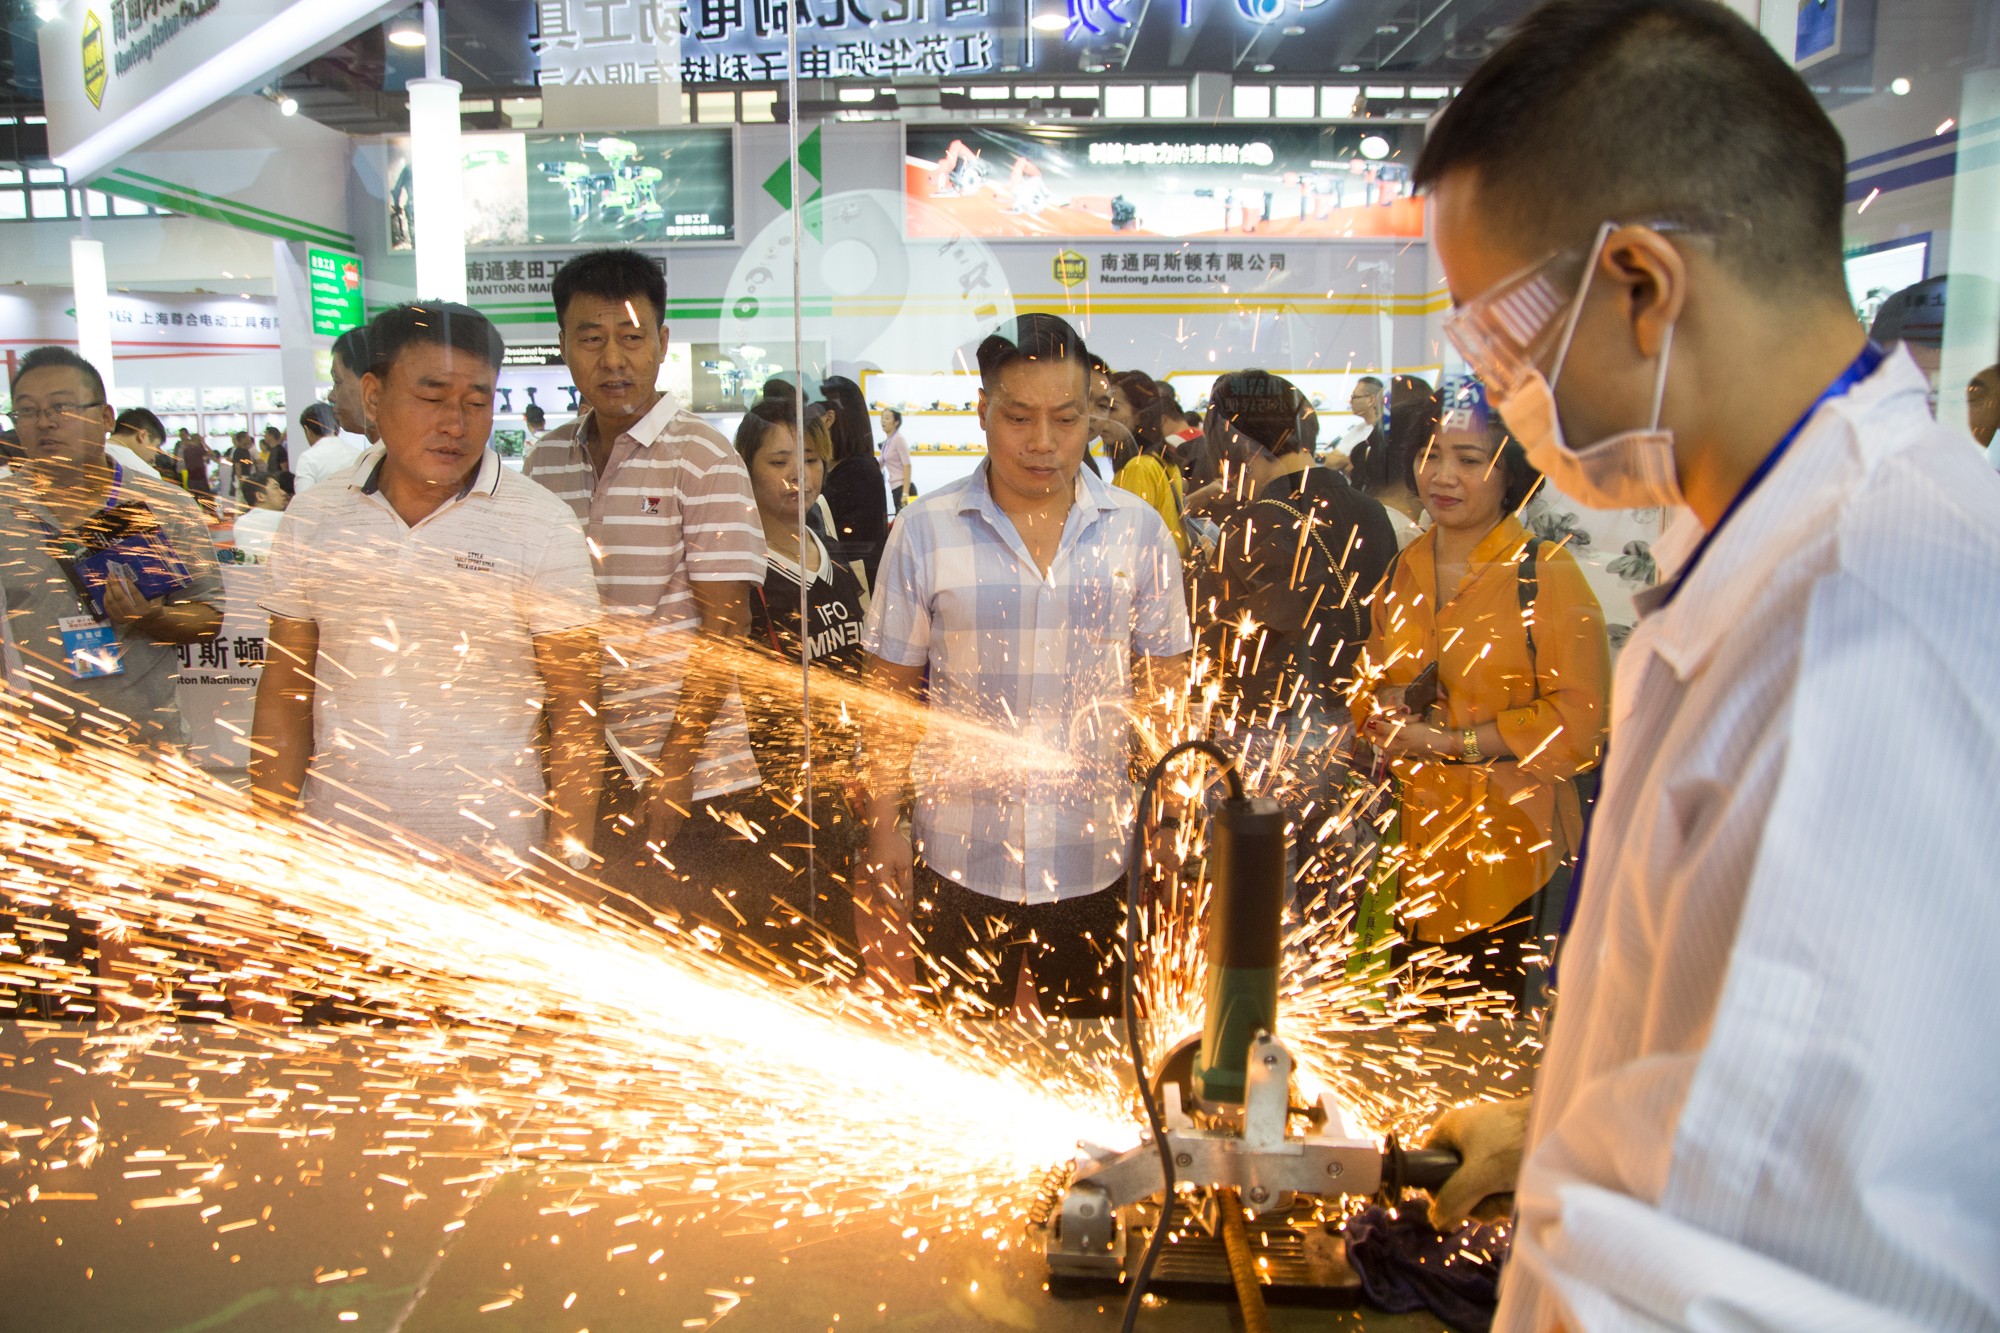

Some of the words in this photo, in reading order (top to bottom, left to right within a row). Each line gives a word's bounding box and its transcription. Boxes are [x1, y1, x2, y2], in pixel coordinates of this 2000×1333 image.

[1100, 252, 1286, 272] 南通阿斯顿有限公司
[1100, 274, 1148, 285] Nantong
[1151, 274, 1184, 284] Aston
[467, 283, 526, 295] NANTONG
[538, 346, 561, 356] foreig
[200, 675, 257, 686] Machinery
